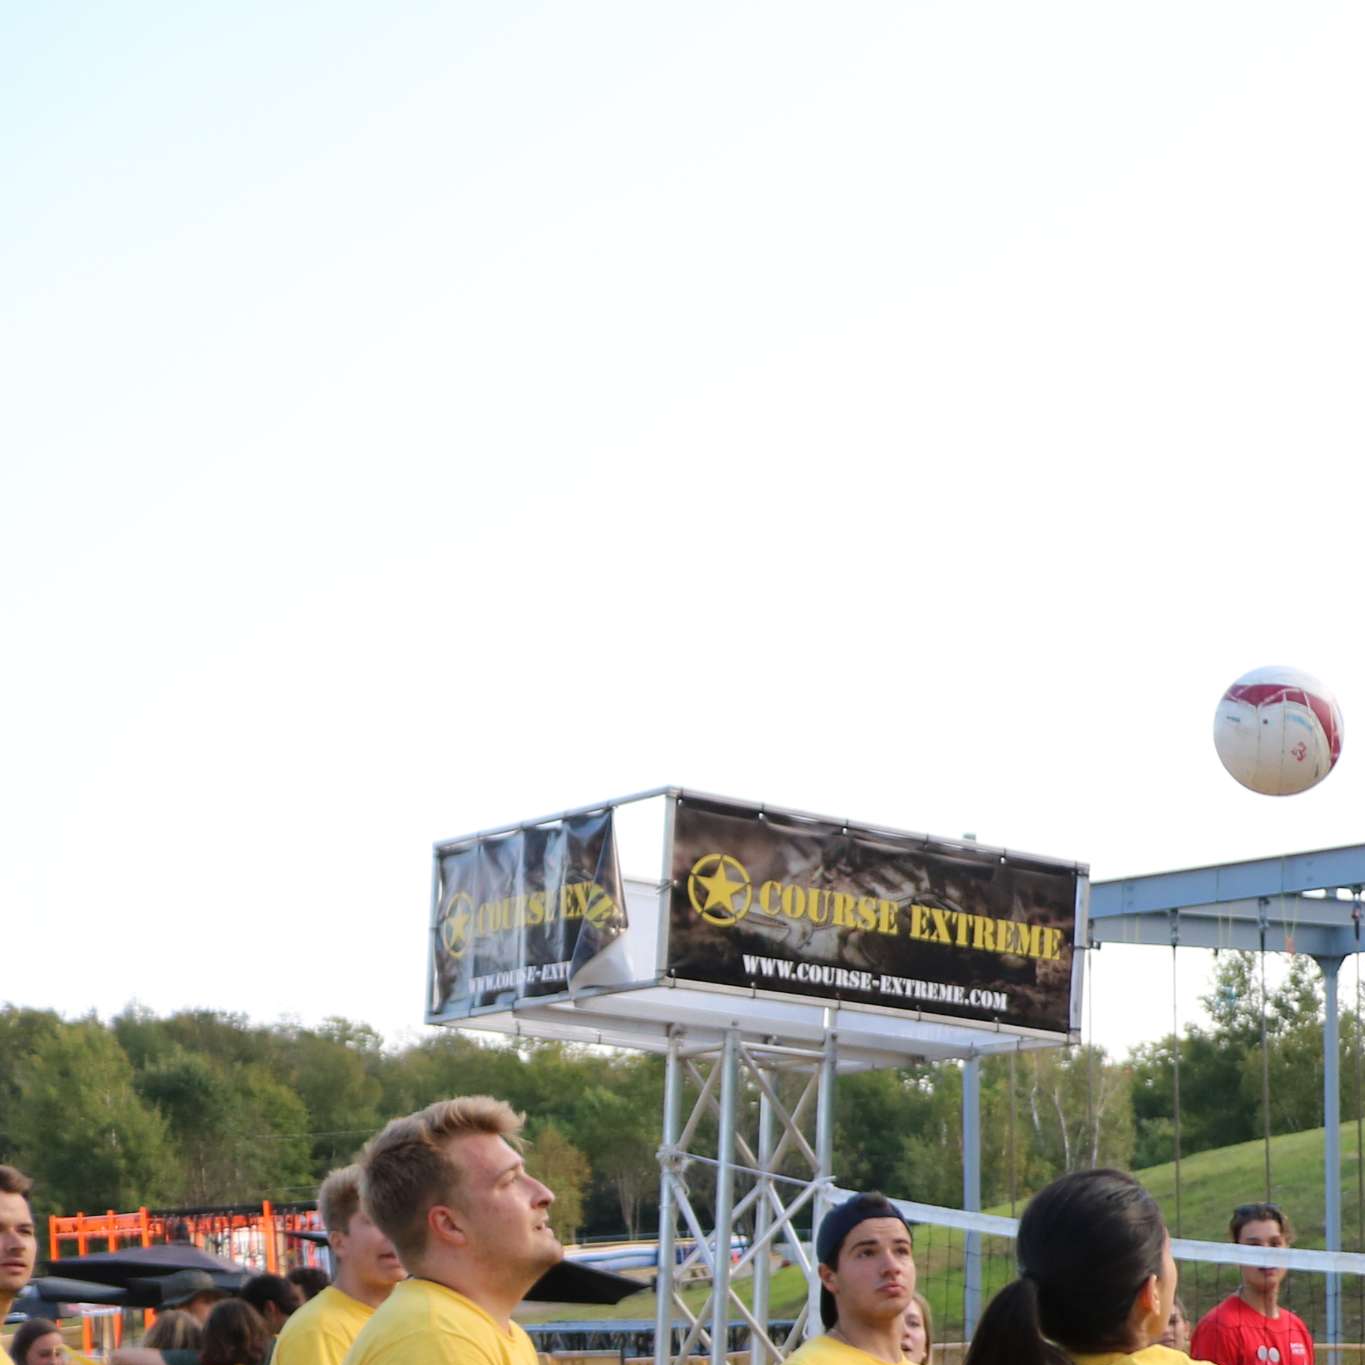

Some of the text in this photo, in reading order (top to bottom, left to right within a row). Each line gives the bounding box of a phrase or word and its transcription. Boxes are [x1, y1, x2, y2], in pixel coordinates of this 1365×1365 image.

[760, 880, 1062, 961] COURSE EXTREME
[742, 954, 1008, 1012] WWW.COURSE-EXTREME.COM
